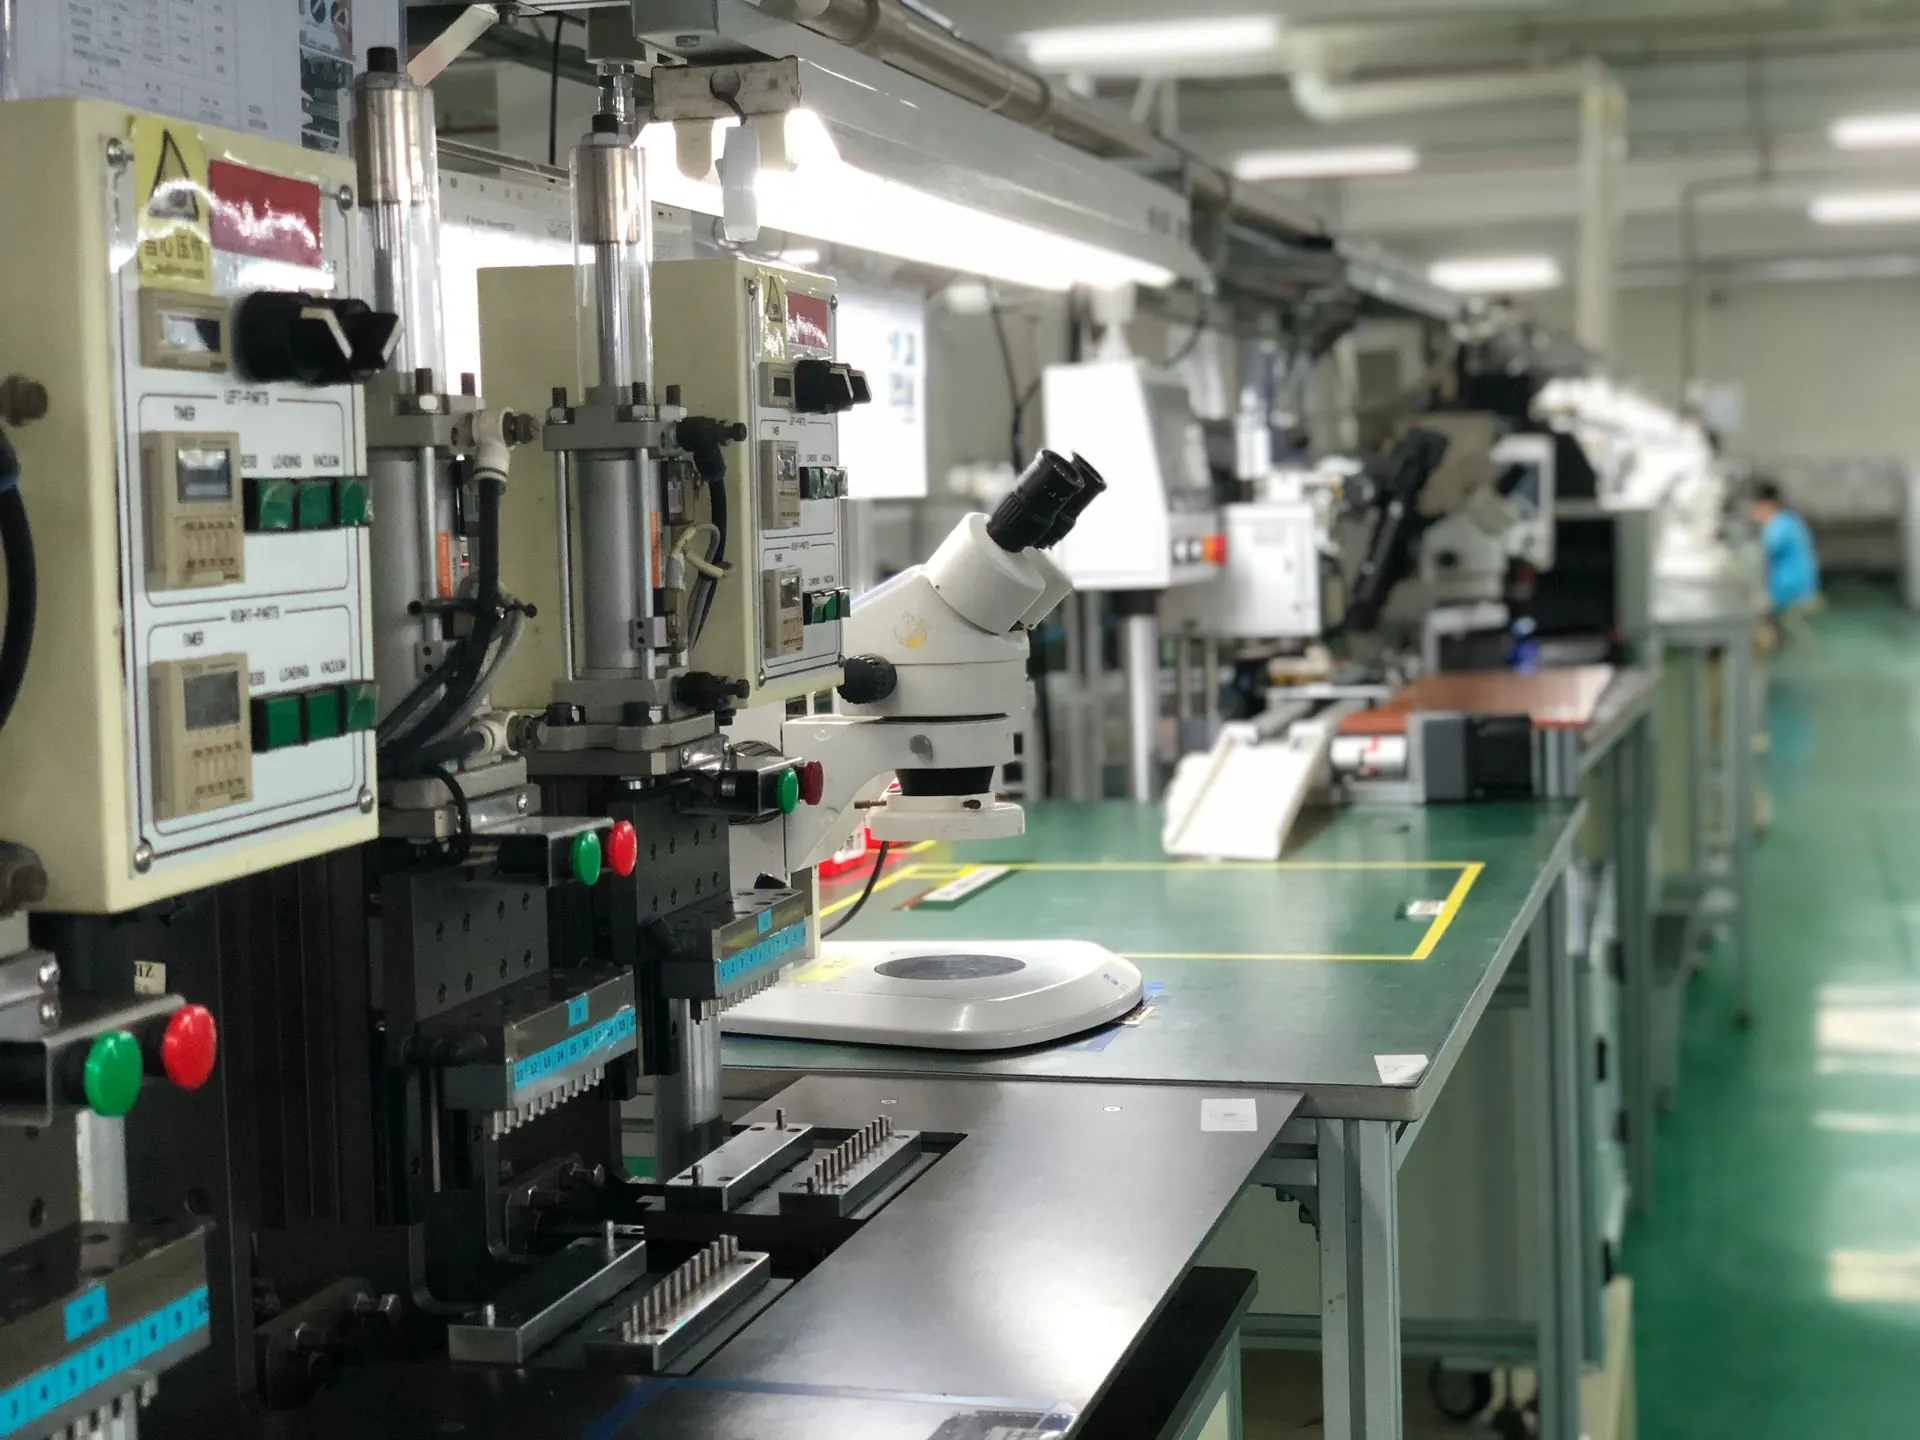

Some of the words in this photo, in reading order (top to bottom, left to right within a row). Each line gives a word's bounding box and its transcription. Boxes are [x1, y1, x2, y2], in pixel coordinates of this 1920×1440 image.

[39, 1383, 48, 1401] 4
[68, 1367, 77, 1386] 5
[96, 1353, 105, 1370] 6
[123, 1337, 131, 1355] 7
[149, 1323, 158, 1342] 8
[174, 1310, 183, 1329] 9
